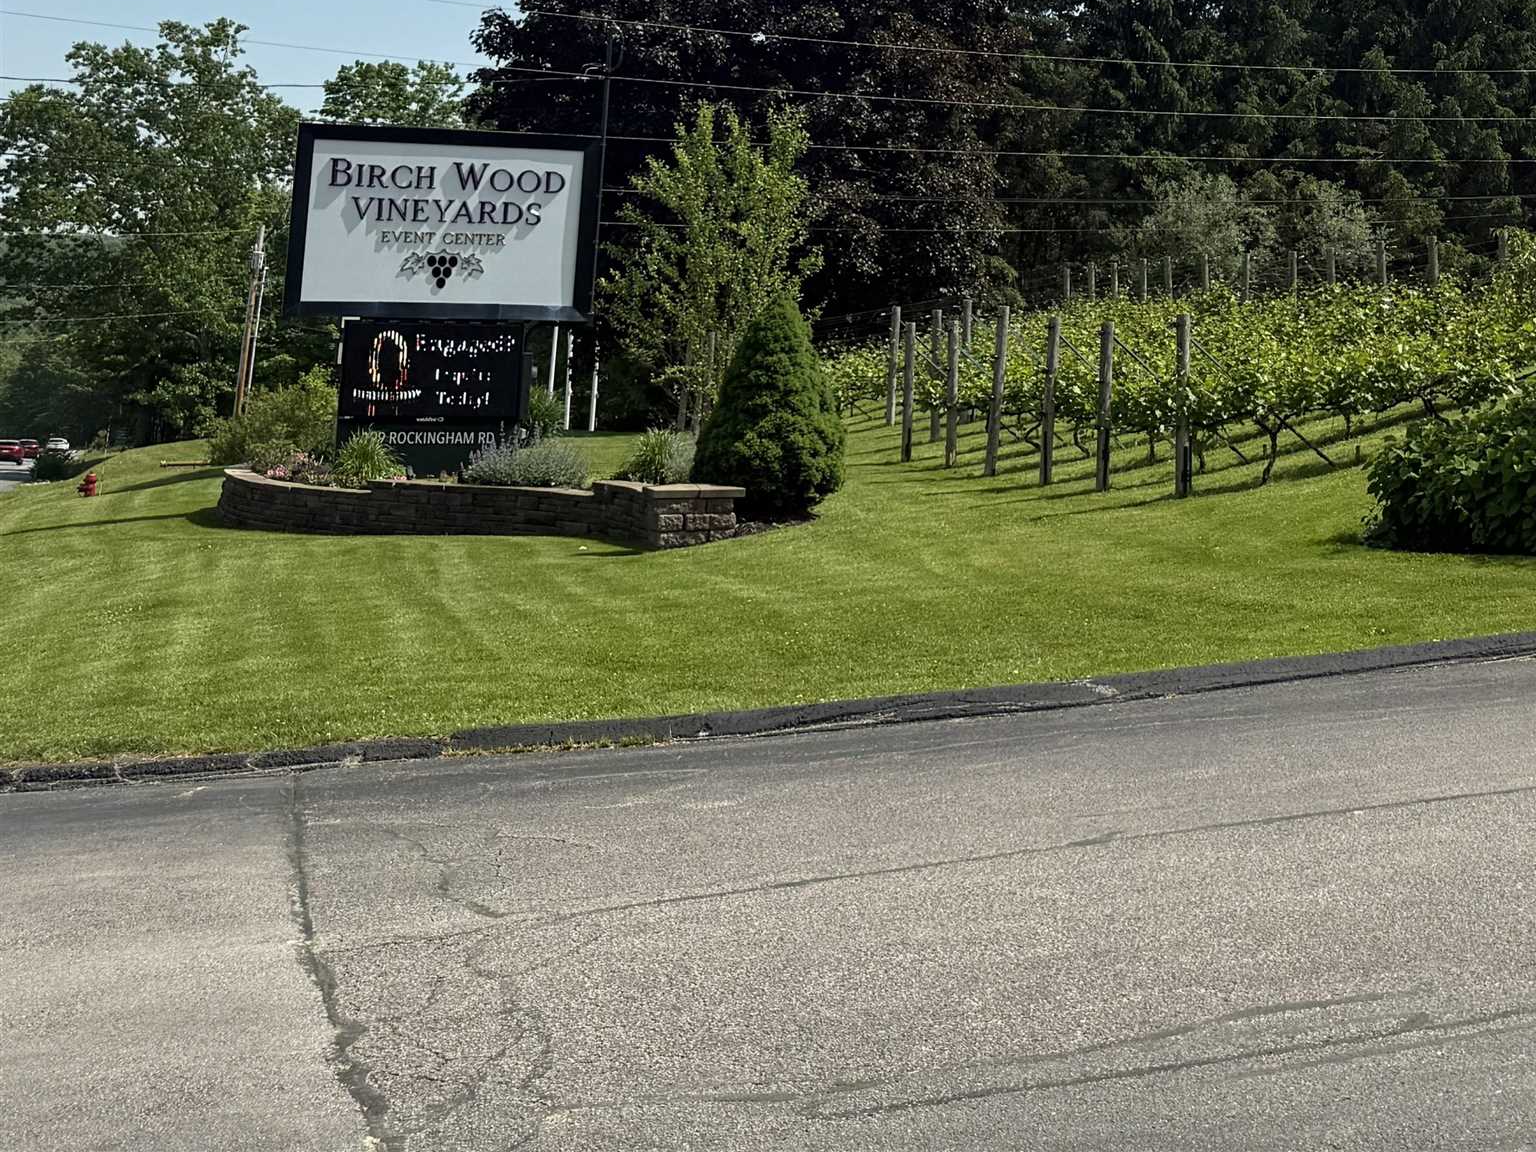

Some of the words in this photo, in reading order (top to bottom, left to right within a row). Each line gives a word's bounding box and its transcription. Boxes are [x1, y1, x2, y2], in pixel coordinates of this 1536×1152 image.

[328, 157, 436, 190] BIRCH
[453, 162, 566, 194] WOOD
[352, 196, 542, 226] VINEYARDS
[381, 230, 436, 246] EVENT
[442, 232, 506, 247] CENTER
[388, 431, 474, 445] ROCKINGHAM
[478, 431, 495, 445] RD
